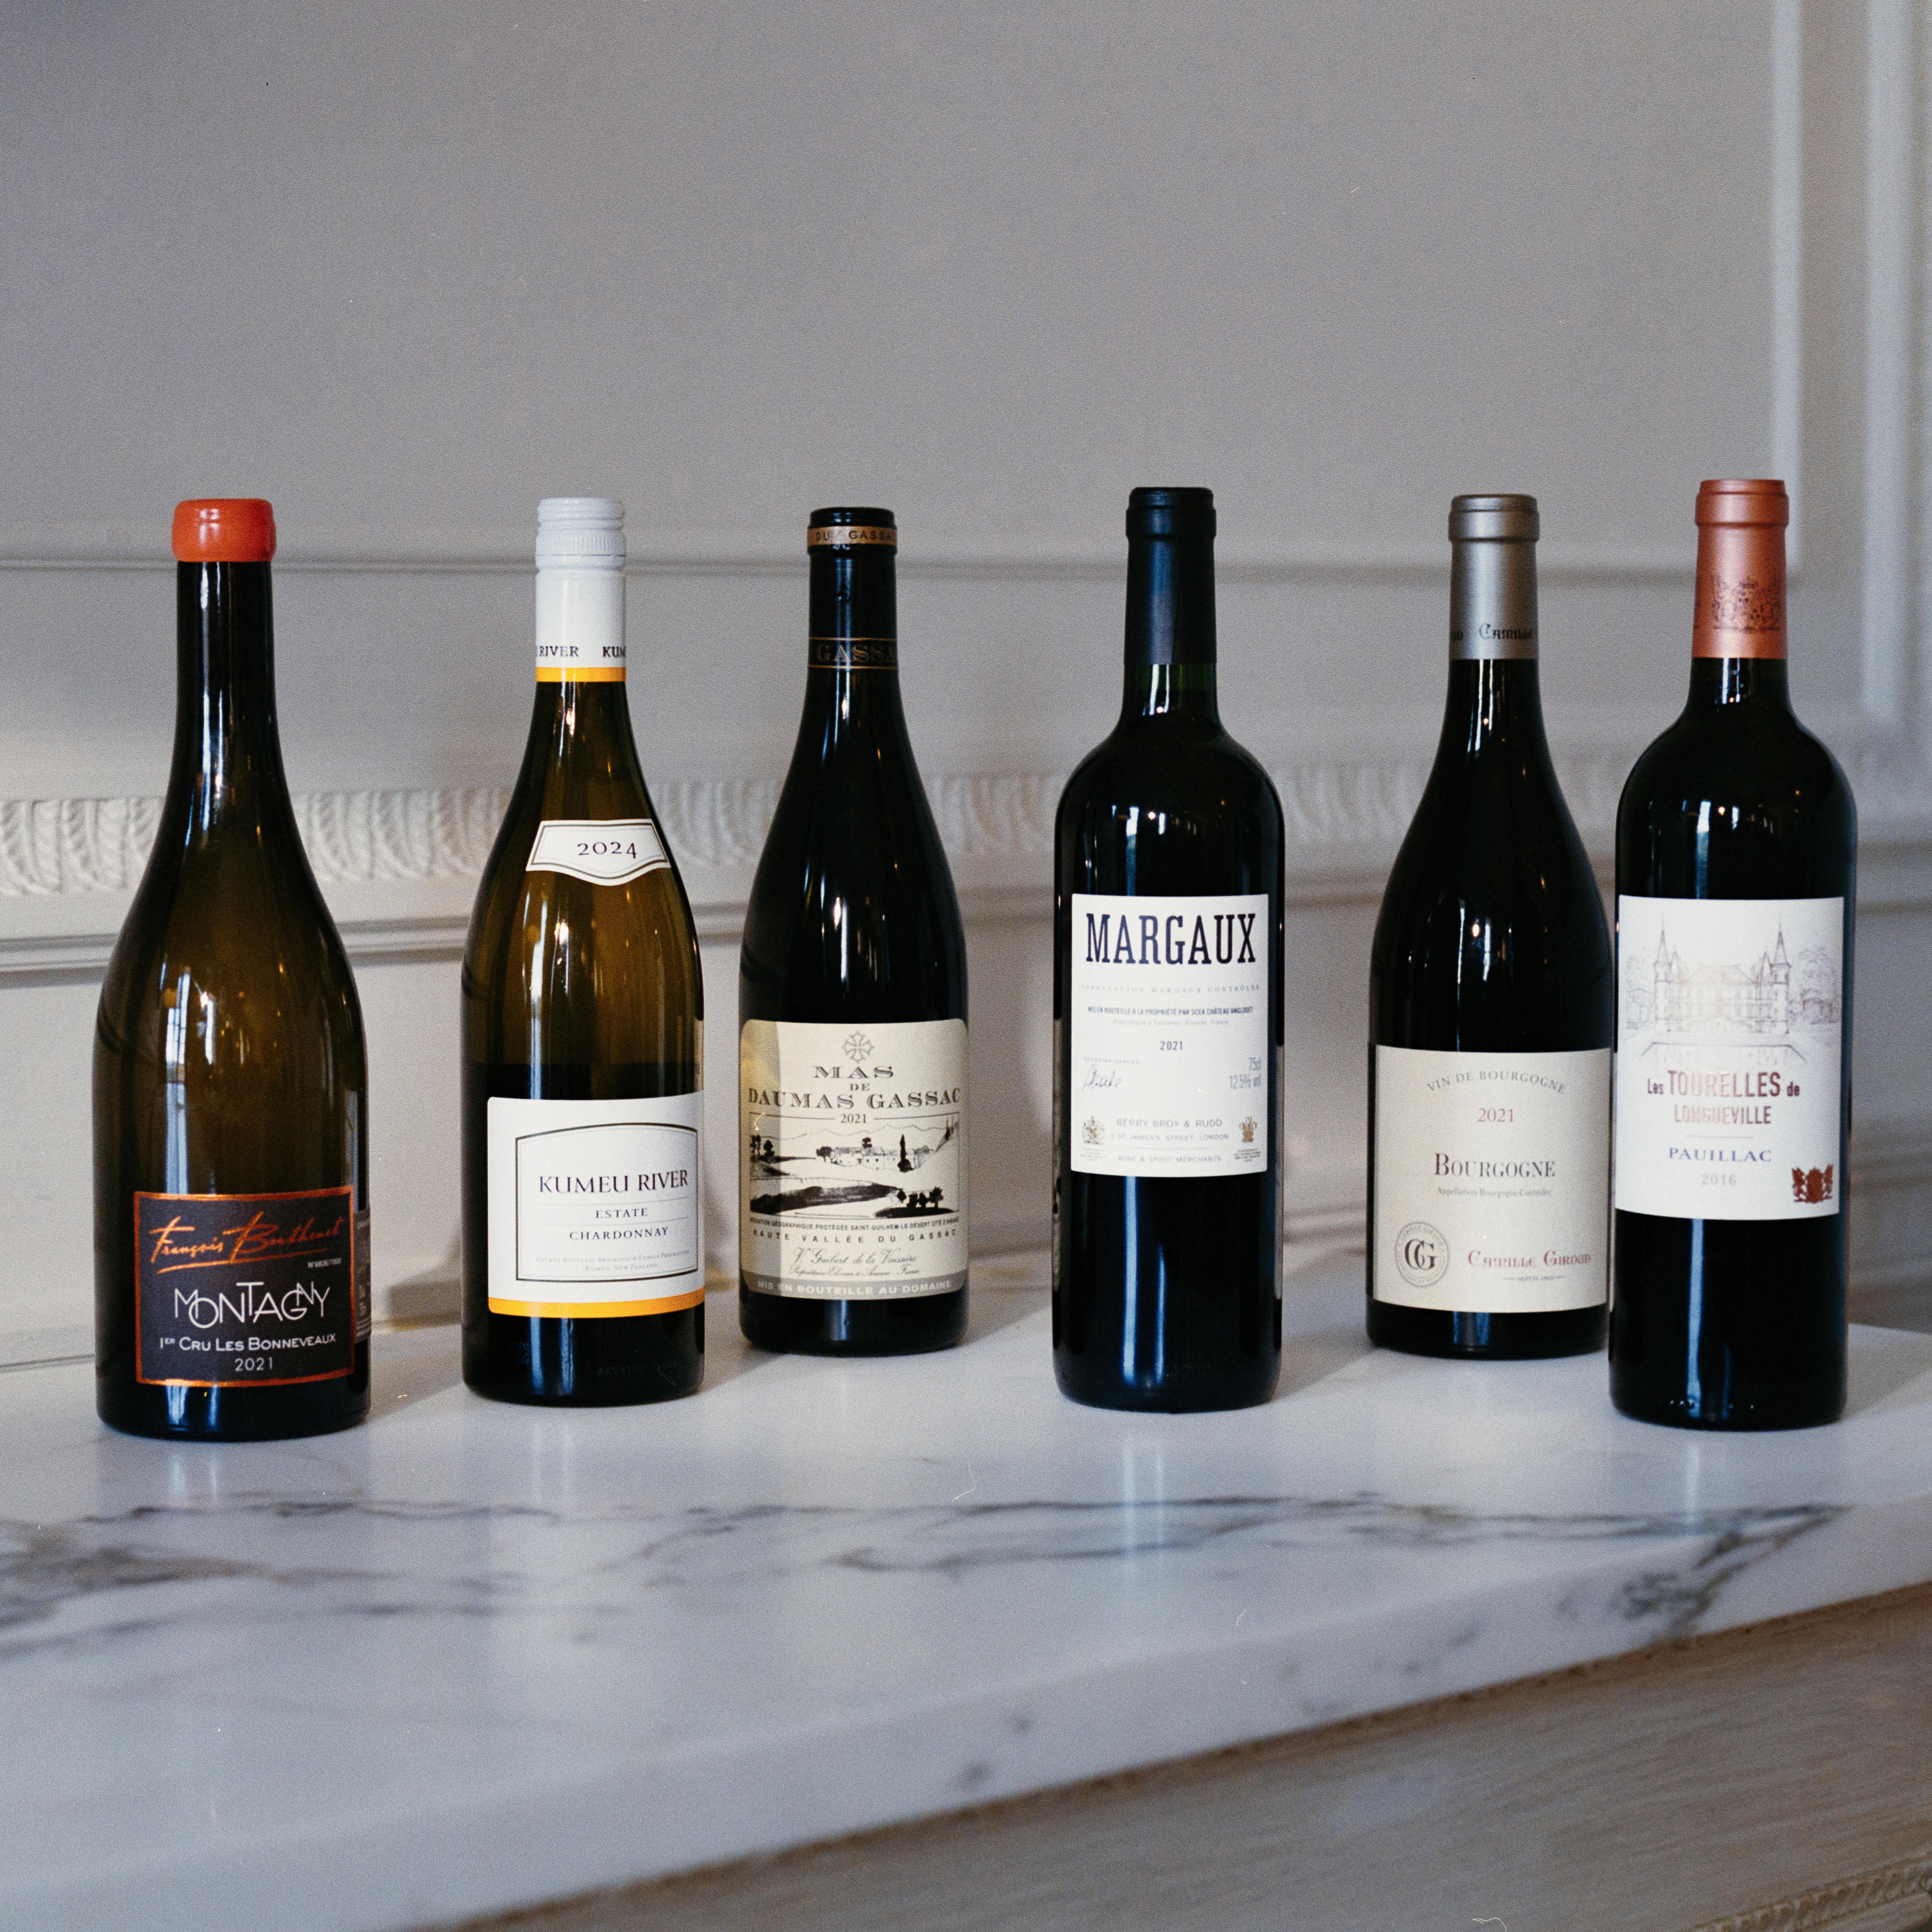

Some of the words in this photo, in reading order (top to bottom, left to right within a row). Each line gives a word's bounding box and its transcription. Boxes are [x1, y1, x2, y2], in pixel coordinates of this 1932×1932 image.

[539, 646, 579, 657] RIVER
[577, 842, 638, 859] 2024
[1086, 913, 1256, 965] MARGAUX
[1160, 1040, 1184, 1051] 2021
[813, 1066, 894, 1079] MAS
[850, 1083, 870, 1092] DE
[1427, 1075, 1451, 1092] VIN
[1455, 1072, 1473, 1083] DE
[1479, 1070, 1565, 1094] BOURGOGNE
[1647, 1078, 1664, 1095] Les
[1667, 1070, 1781, 1098] TOURELLES
[1786, 1082, 1800, 1097] de
[748, 1087, 854, 1109] DAUMAS
[866, 1087, 961, 1109] GASSAC
[840, 1113, 868, 1125] 2021
[1477, 1108, 1515, 1123] 2021
[1674, 1104, 1772, 1125] LONGUEVILLE
[1117, 1118, 1148, 1127] BERRY
[1195, 1118, 1222, 1127] RUDD
[1668, 1147, 1772, 1163] PAUILLAC
[1433, 1152, 1556, 1179] BOURGOGNE
[539, 1175, 629, 1194] KUMEU
[638, 1169, 689, 1191] RIVER
[1701, 1173, 1737, 1187] 2016
[595, 1208, 649, 1219] ESTATE
[569, 1226, 669, 1241] CHARDONNAY
[802, 1235, 864, 1243] VALLÉE
[878, 1235, 896, 1243] DU
[908, 1228, 957, 1242] GASSAC
[797, 1284, 873, 1295] BOUTEILLE
[879, 1285, 897, 1294] AU
[174, 1281, 330, 1329] MONTAGNY
[179, 1337, 211, 1352] CRU
[216, 1338, 245, 1352] LES
[248, 1333, 337, 1351] BONNEVEAUX
[235, 1357, 273, 1372] 2021
